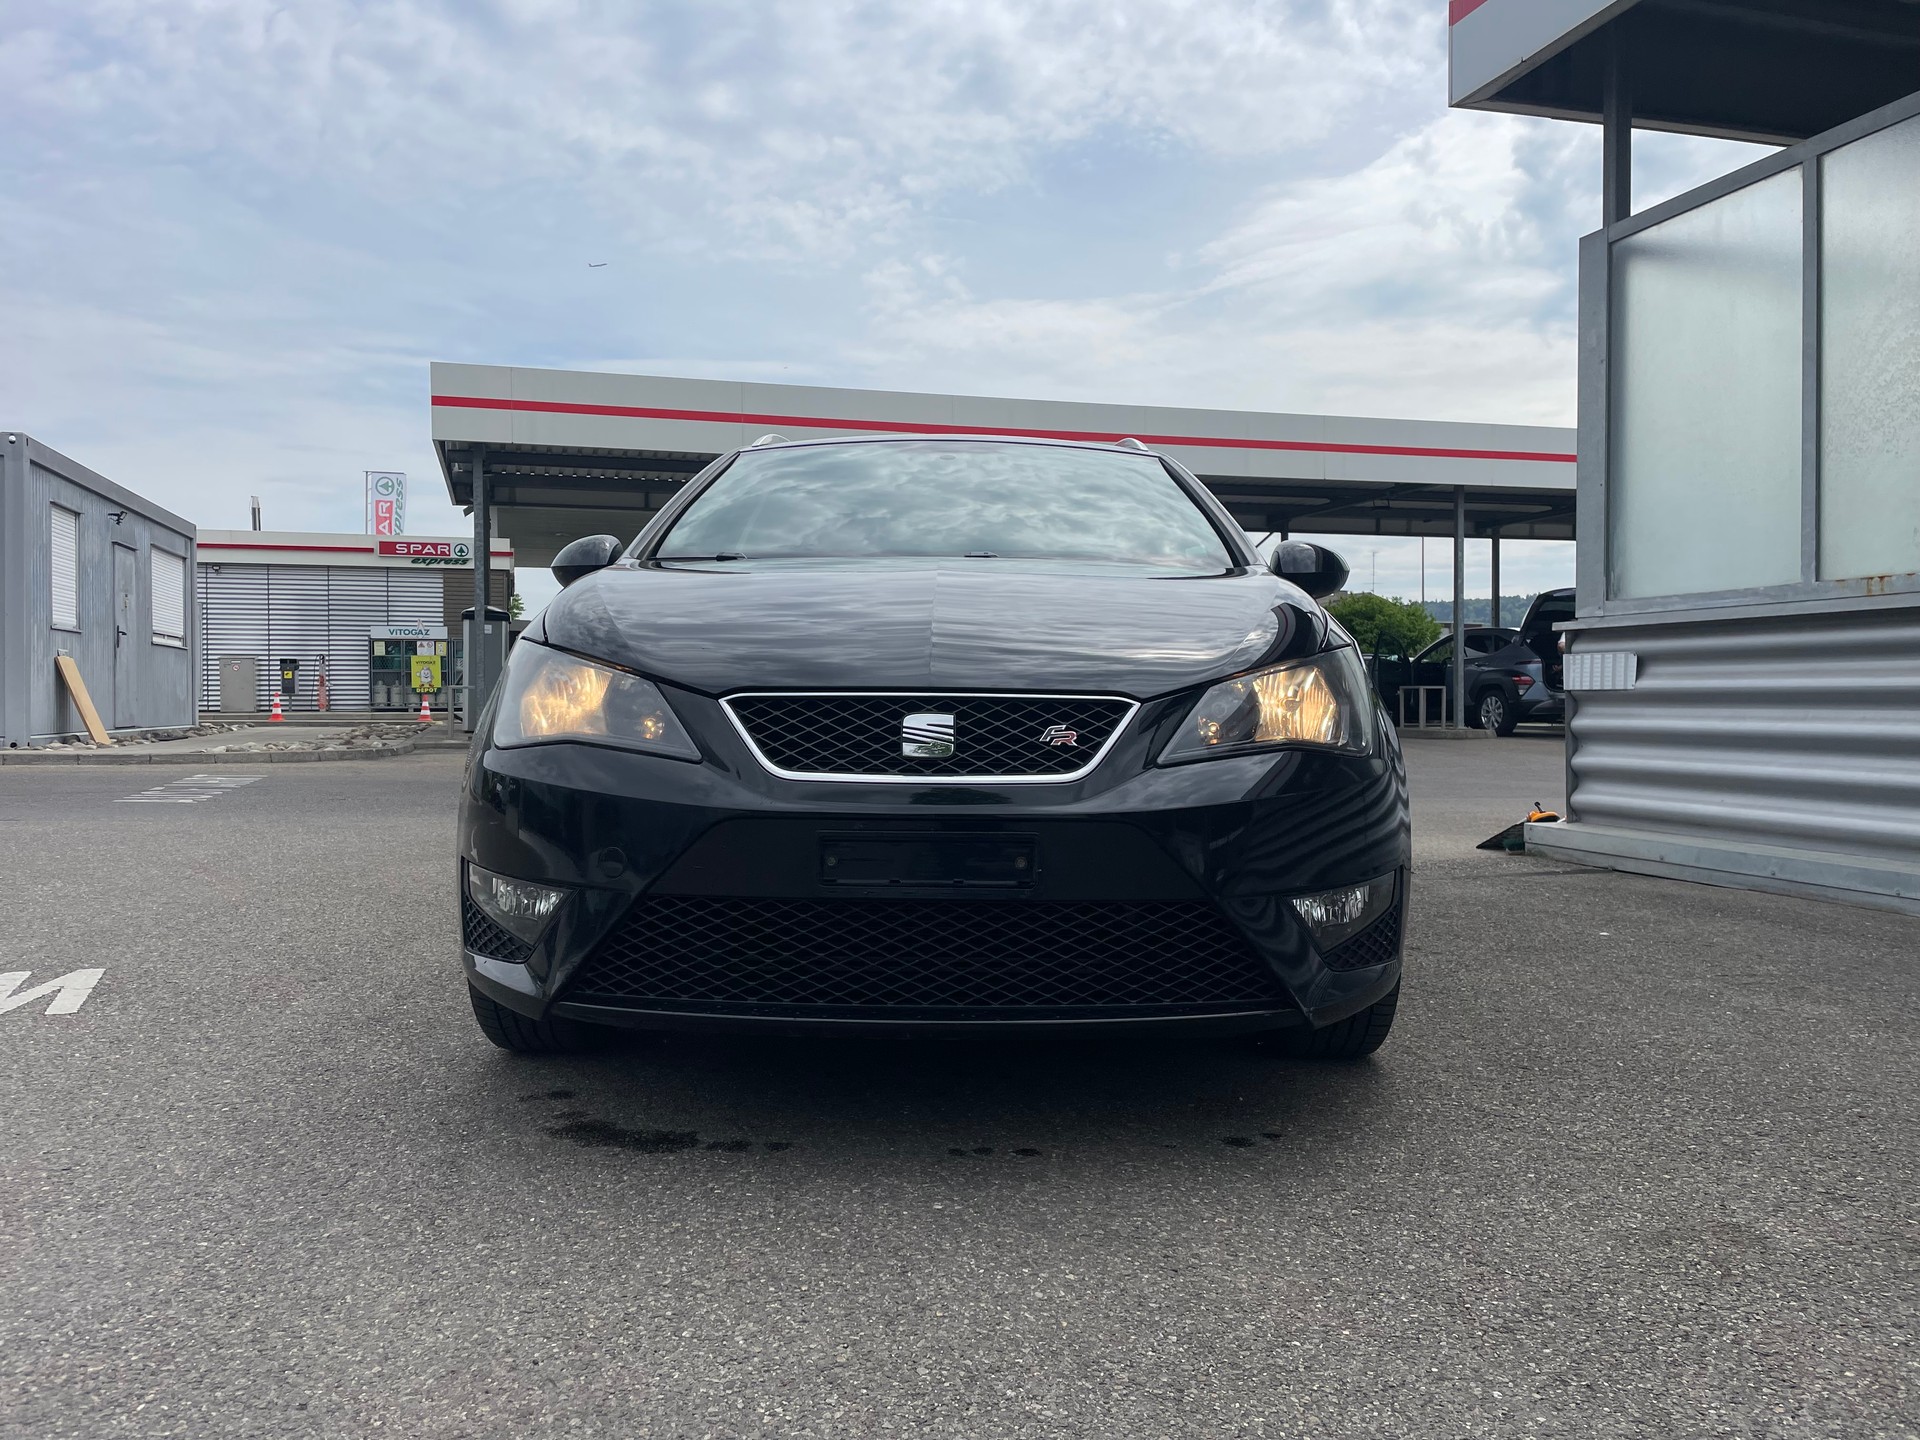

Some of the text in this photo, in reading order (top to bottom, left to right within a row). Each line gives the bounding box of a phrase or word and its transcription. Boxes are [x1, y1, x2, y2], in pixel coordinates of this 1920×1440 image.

[378, 501, 390, 535] AR
[395, 543, 450, 555] SPAR
[411, 557, 470, 566] express
[388, 628, 431, 636] VITOGAZ
[1039, 724, 1078, 746] FR
